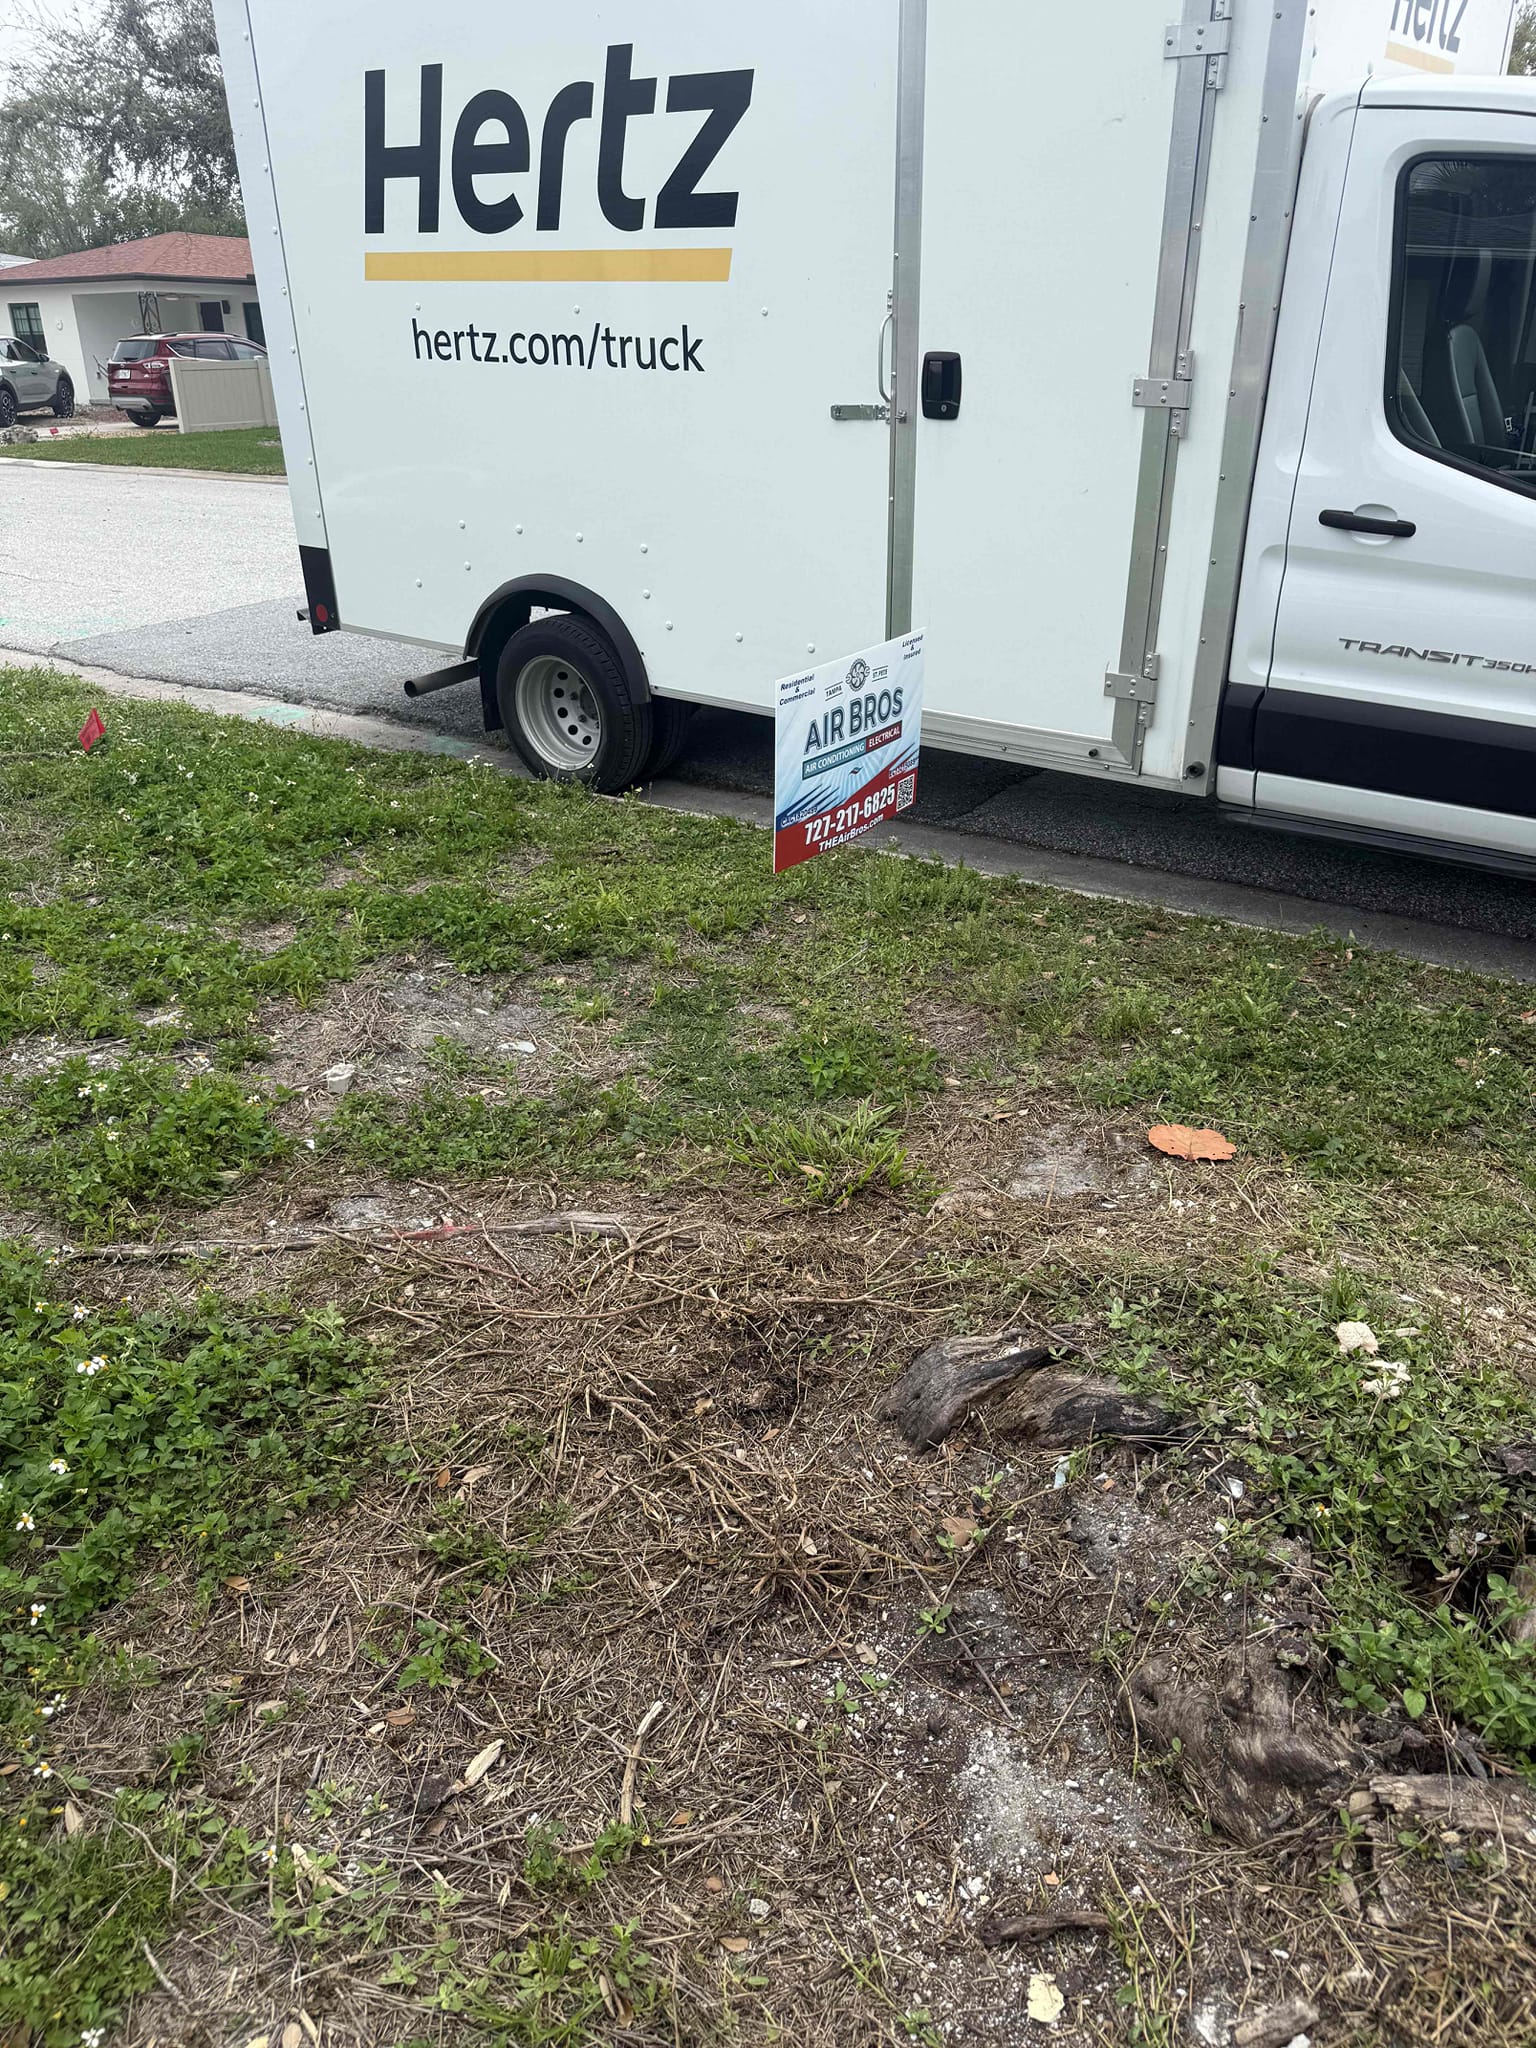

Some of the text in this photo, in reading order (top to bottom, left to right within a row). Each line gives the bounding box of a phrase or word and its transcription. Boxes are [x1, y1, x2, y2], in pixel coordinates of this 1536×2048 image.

[364, 43, 755, 234] Hertz
[411, 317, 705, 372] hertz.com/truck
[902, 634, 924, 648] Licensed
[1339, 637, 1484, 666] TRANSIT
[779, 687, 816, 706] Commercial
[780, 673, 815, 691] Residential
[795, 686, 800, 694] &
[825, 685, 843, 697] TAMPA
[803, 686, 904, 756] AIR BROS
[805, 761, 817, 775] AIR
[817, 742, 865, 769] CONDITIONING
[868, 726, 901, 748] ELECTRICAL
[804, 783, 896, 846] 727-217-6825
[818, 813, 884, 853] THEAirBros.com
